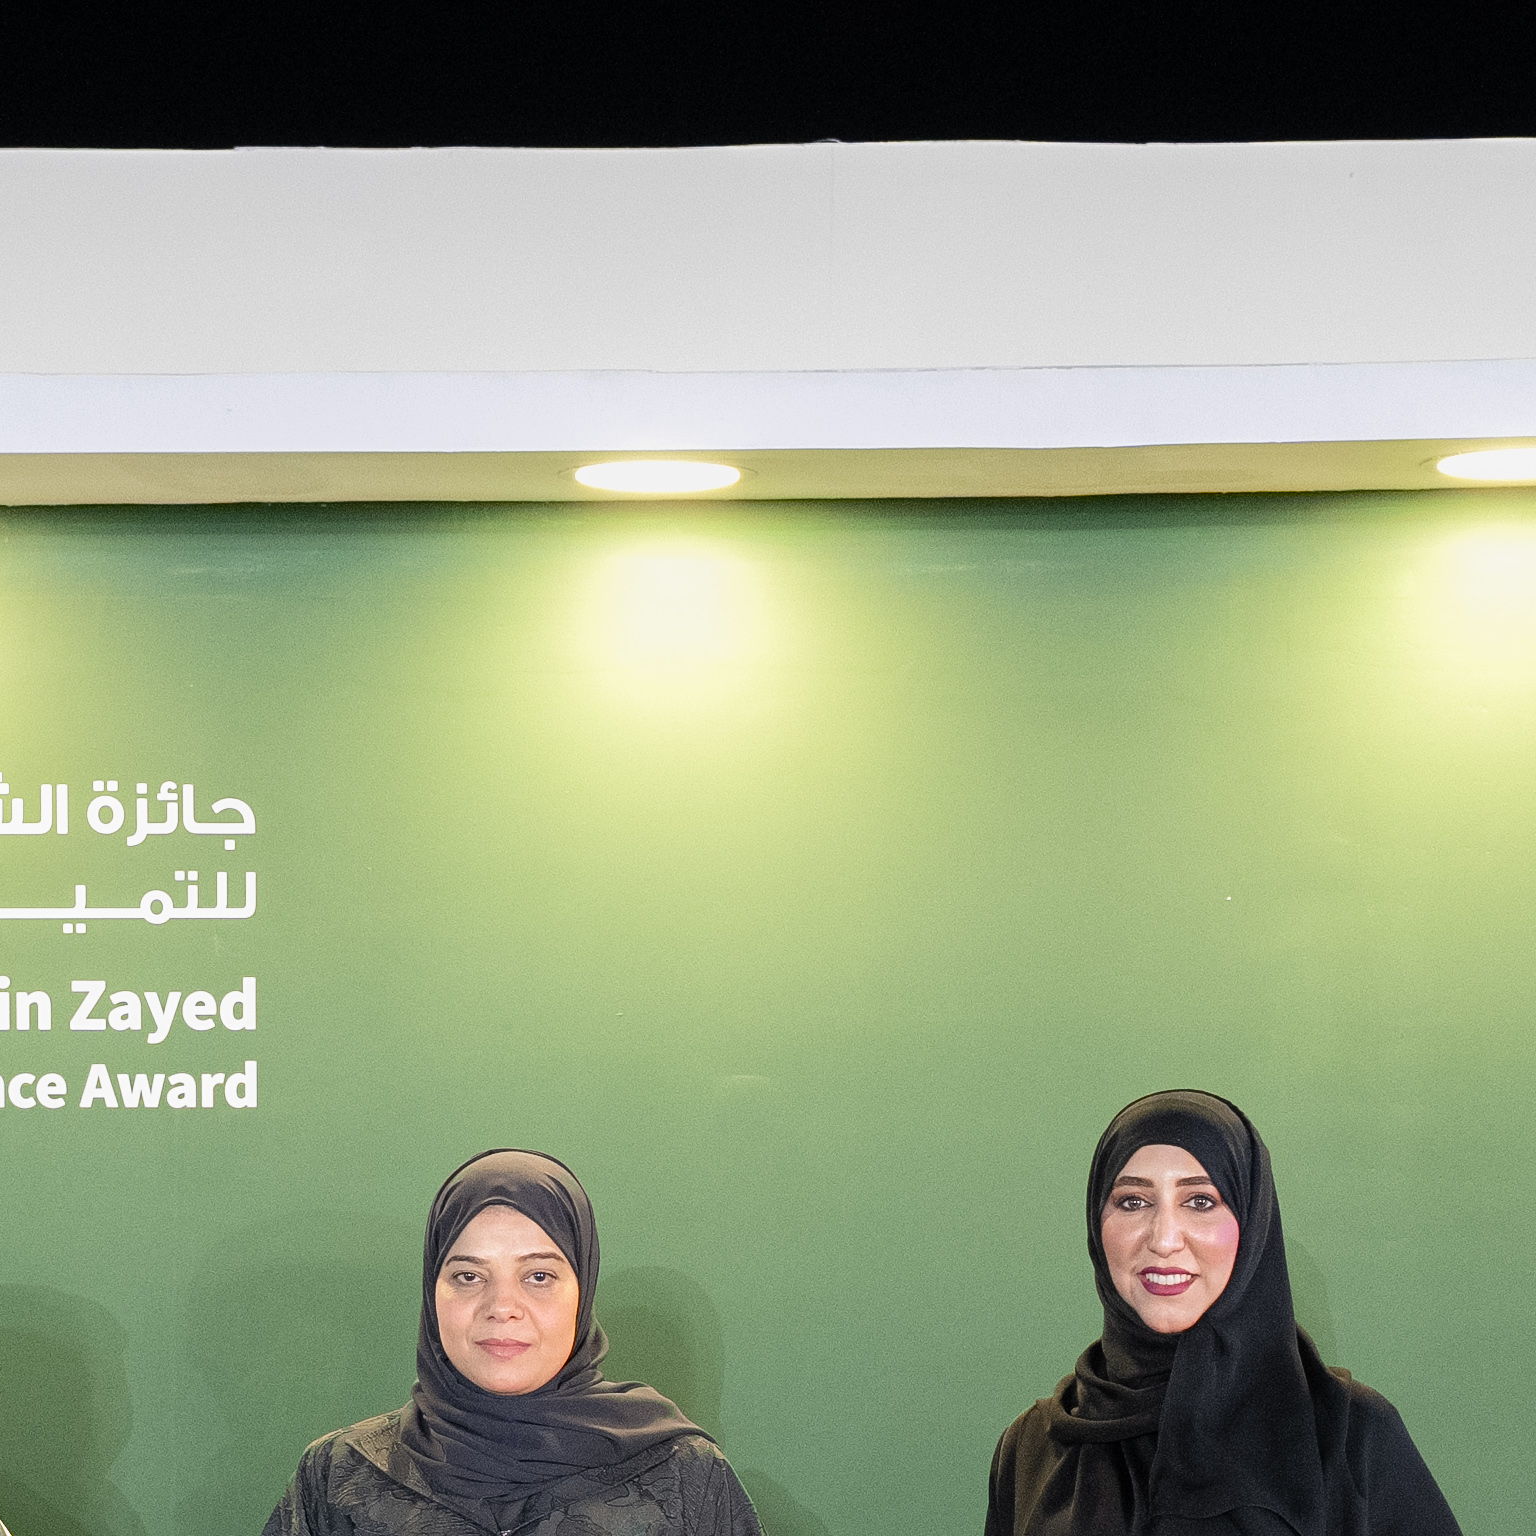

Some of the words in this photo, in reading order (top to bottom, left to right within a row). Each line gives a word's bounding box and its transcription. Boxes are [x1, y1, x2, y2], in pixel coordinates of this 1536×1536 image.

[87, 779, 256, 851] جائزة
[69, 976, 257, 1044] Zayed
[79, 1060, 258, 1109] Award
